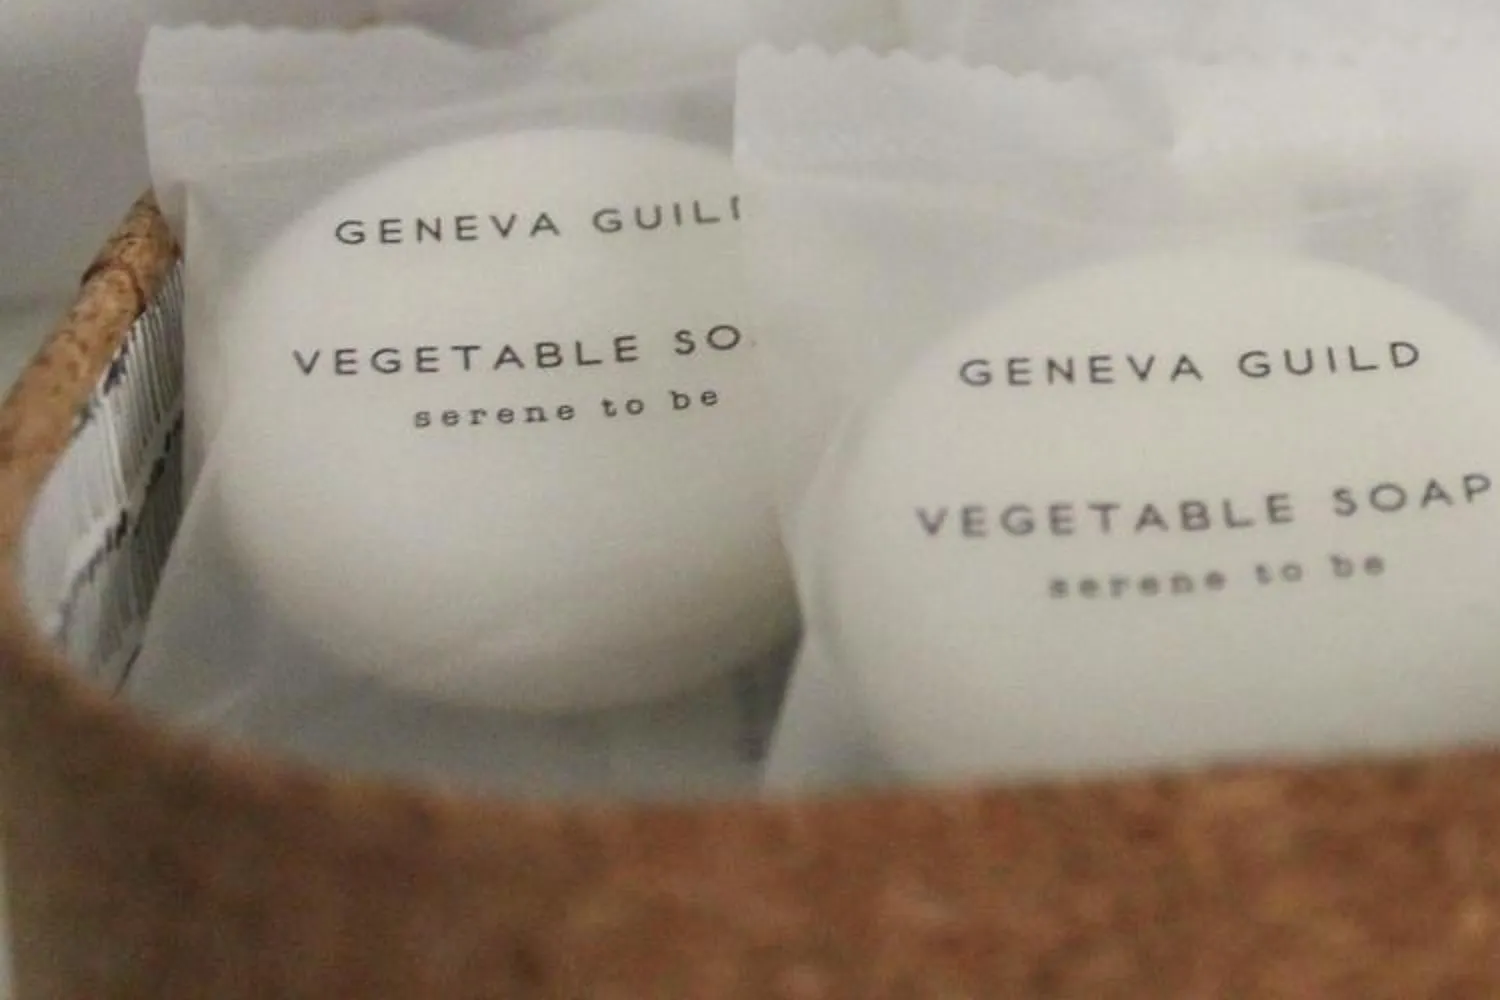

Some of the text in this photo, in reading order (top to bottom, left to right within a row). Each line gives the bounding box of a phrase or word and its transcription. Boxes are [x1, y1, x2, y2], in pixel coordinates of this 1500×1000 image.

[336, 212, 560, 245] GENEVA
[294, 324, 756, 376] VEGETABLE SO
[959, 340, 1421, 388] GENEVA GUILD
[414, 387, 720, 429] serene to be
[915, 473, 1494, 538] VEGETABLE SOAP
[1048, 550, 1388, 599] serene to be
